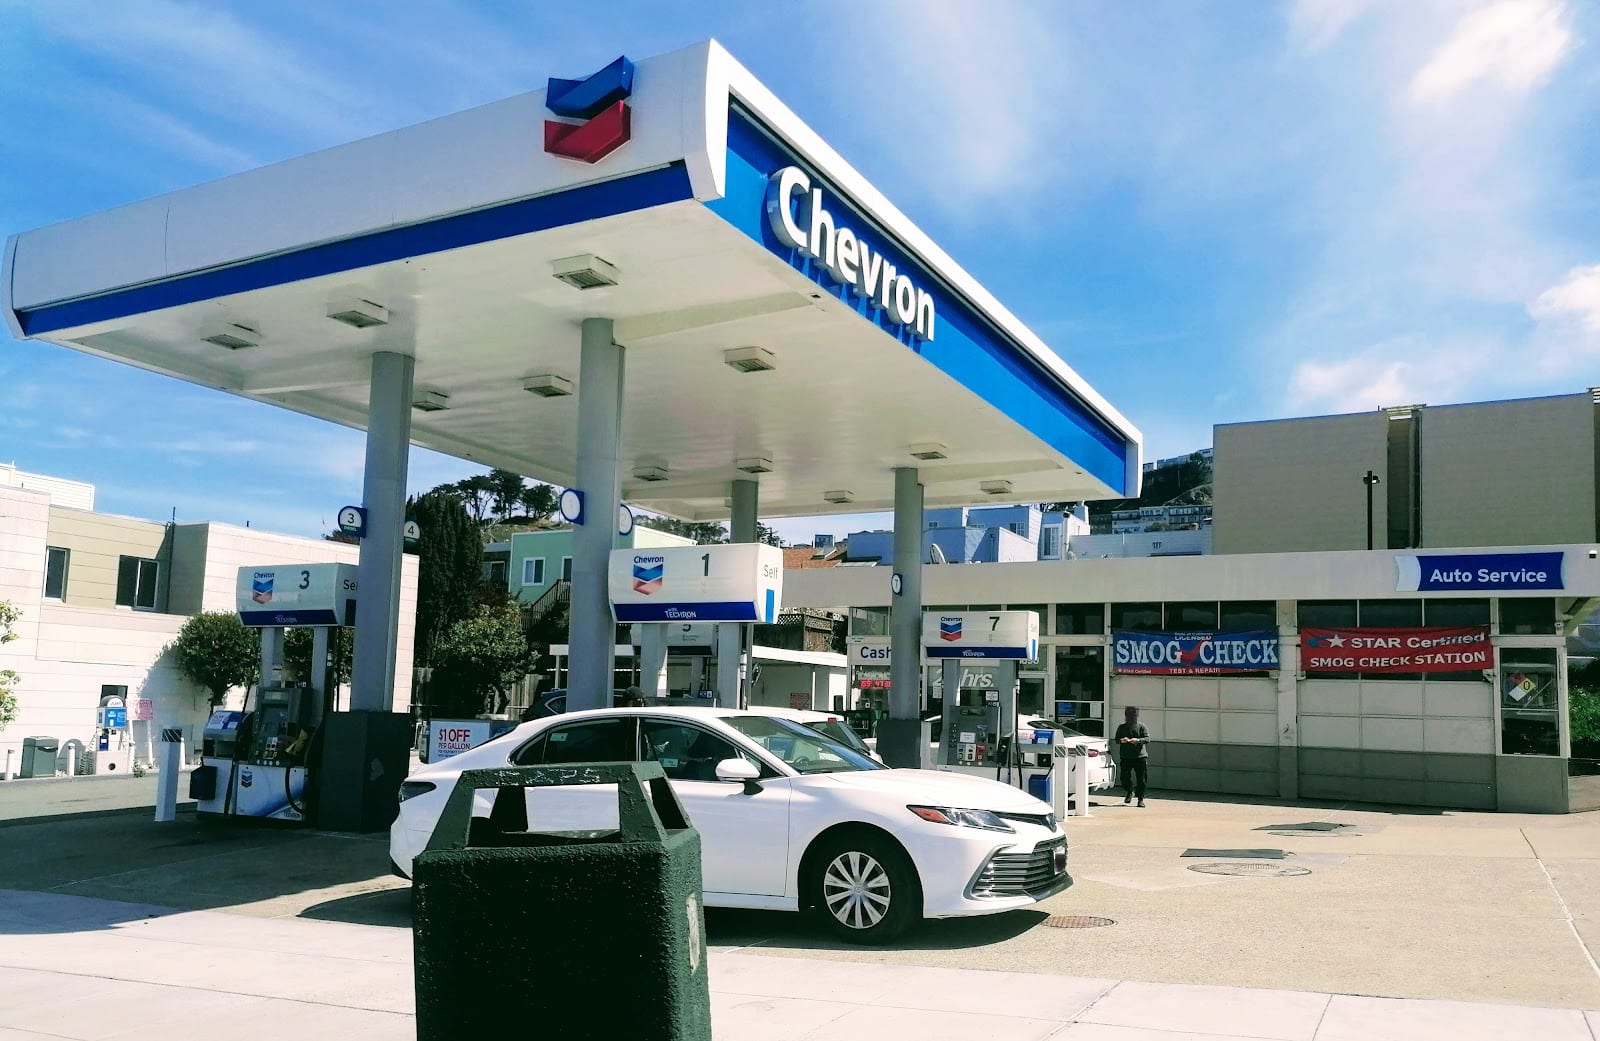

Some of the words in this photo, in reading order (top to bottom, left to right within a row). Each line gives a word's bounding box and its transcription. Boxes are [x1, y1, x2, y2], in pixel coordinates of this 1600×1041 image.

[770, 166, 934, 342] Chevron
[347, 512, 355, 524] 3
[408, 525, 415, 536] 4
[633, 555, 664, 564] Chevron
[701, 553, 709, 576] 1
[299, 570, 310, 590] 3
[763, 564, 779, 580] Self
[1430, 568, 1473, 583] Auto
[1477, 568, 1547, 583] Service
[989, 616, 1000, 631] 7
[1351, 637, 1401, 648] STAR
[1407, 632, 1485, 648] Certified
[1116, 639, 1182, 664] SMOG
[1200, 639, 1278, 664] CHECK
[1310, 657, 1354, 668] SMOG
[1359, 656, 1410, 668] CHECK
[1415, 651, 1485, 665] STATION
[961, 669, 994, 687] hrs.
[448, 729, 470, 742] OFF
[448, 742, 470, 750] GALLON
